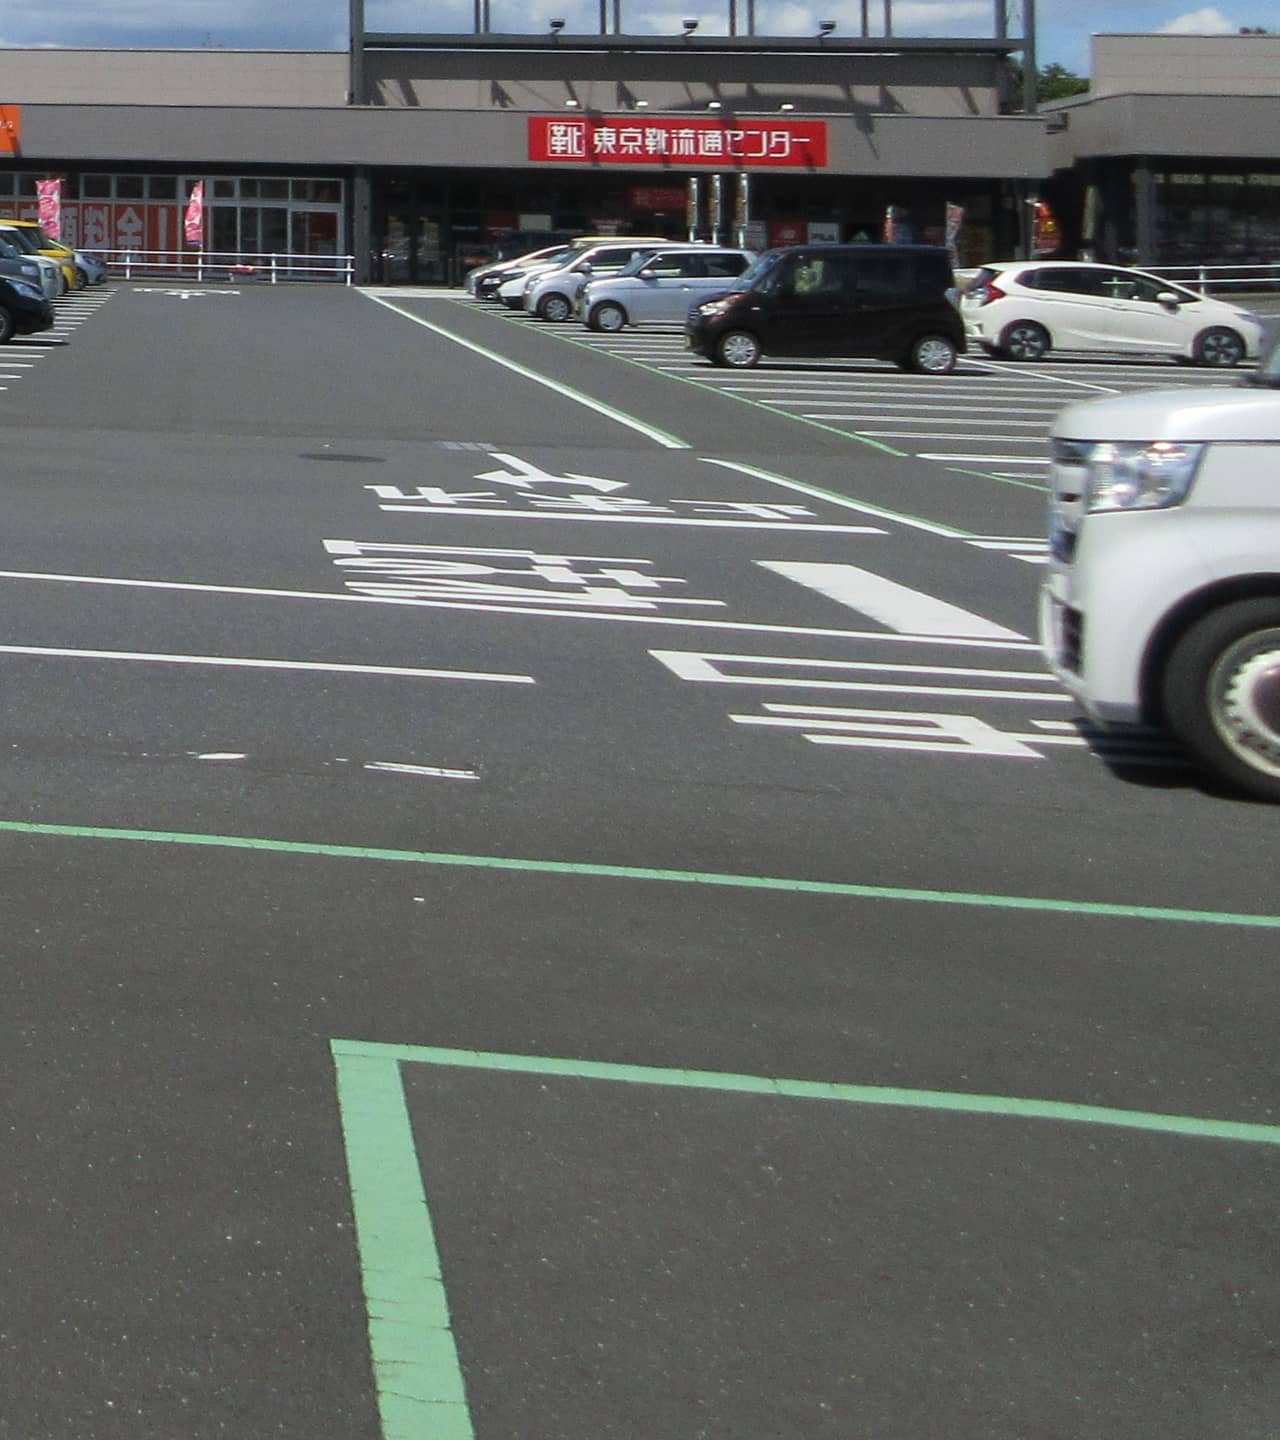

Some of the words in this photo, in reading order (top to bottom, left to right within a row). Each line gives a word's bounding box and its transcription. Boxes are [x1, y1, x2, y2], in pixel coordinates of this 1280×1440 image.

[593, 126, 811, 157] 東京靴流通センター
